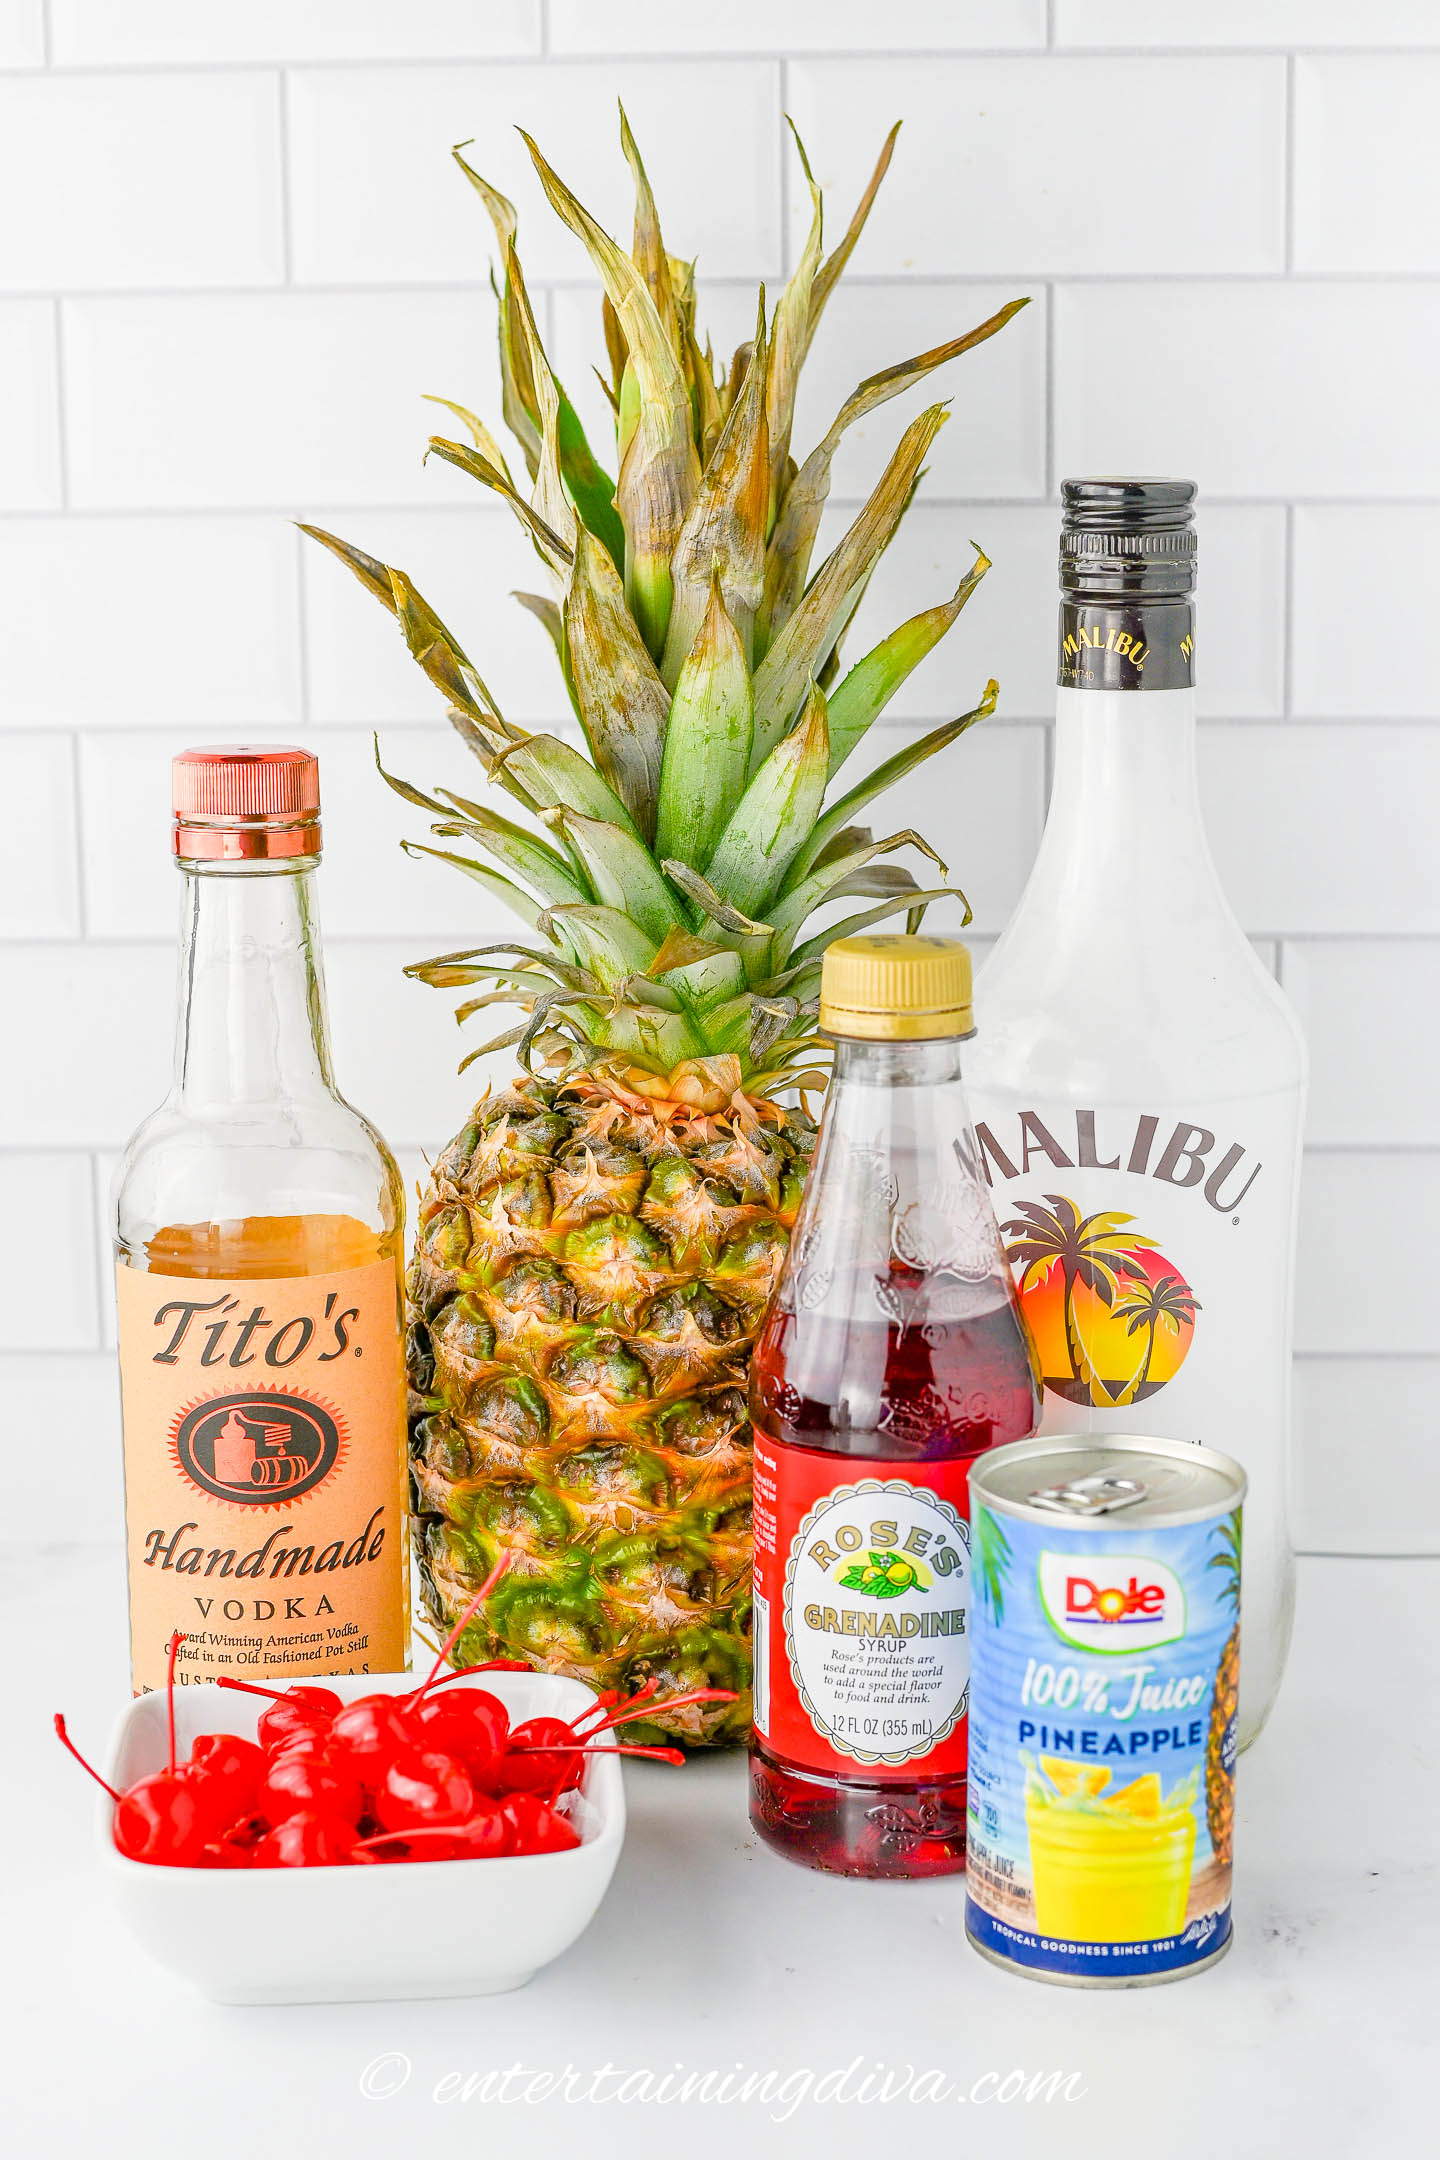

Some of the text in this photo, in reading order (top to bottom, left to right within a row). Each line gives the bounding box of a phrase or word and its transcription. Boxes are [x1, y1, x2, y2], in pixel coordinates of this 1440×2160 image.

[1063, 625, 1151, 665] MALIBU
[953, 1109, 1262, 1213] MALIBU
[153, 1292, 360, 1369] Tito's
[144, 1506, 386, 1579] Handmade
[808, 1520, 963, 1578] ROSE'S
[194, 1593, 335, 1620] VODKA
[1065, 1576, 1166, 1621] Dole
[209, 1634, 264, 1650] Winning
[265, 1632, 324, 1648] American
[326, 1622, 360, 1640] Vodka
[803, 1603, 966, 1638] GRENADINE
[202, 1650, 214, 1662] in
[218, 1654, 233, 1663] an
[236, 1649, 260, 1664] Old
[262, 1647, 322, 1664] Fashioned
[325, 1646, 345, 1657] Pot
[346, 1634, 369, 1652] Still
[831, 1649, 935, 1666] Rose's products are
[858, 1638, 907, 1653] SYRUP
[823, 1663, 944, 1678] used around the world
[824, 1675, 943, 1694] to add a special flavor
[834, 1690, 931, 1704] to food and drink.
[1021, 1657, 1208, 1721] 100% Juice
[832, 1714, 933, 1736] 12 FL OZ (355 mL)
[1018, 1719, 1203, 1755] PINEAPPLE
[991, 1920, 1037, 1948] TROPICAL
[1040, 1940, 1109, 1957] GOODNESS
[1112, 1944, 1149, 1956] SINCE
